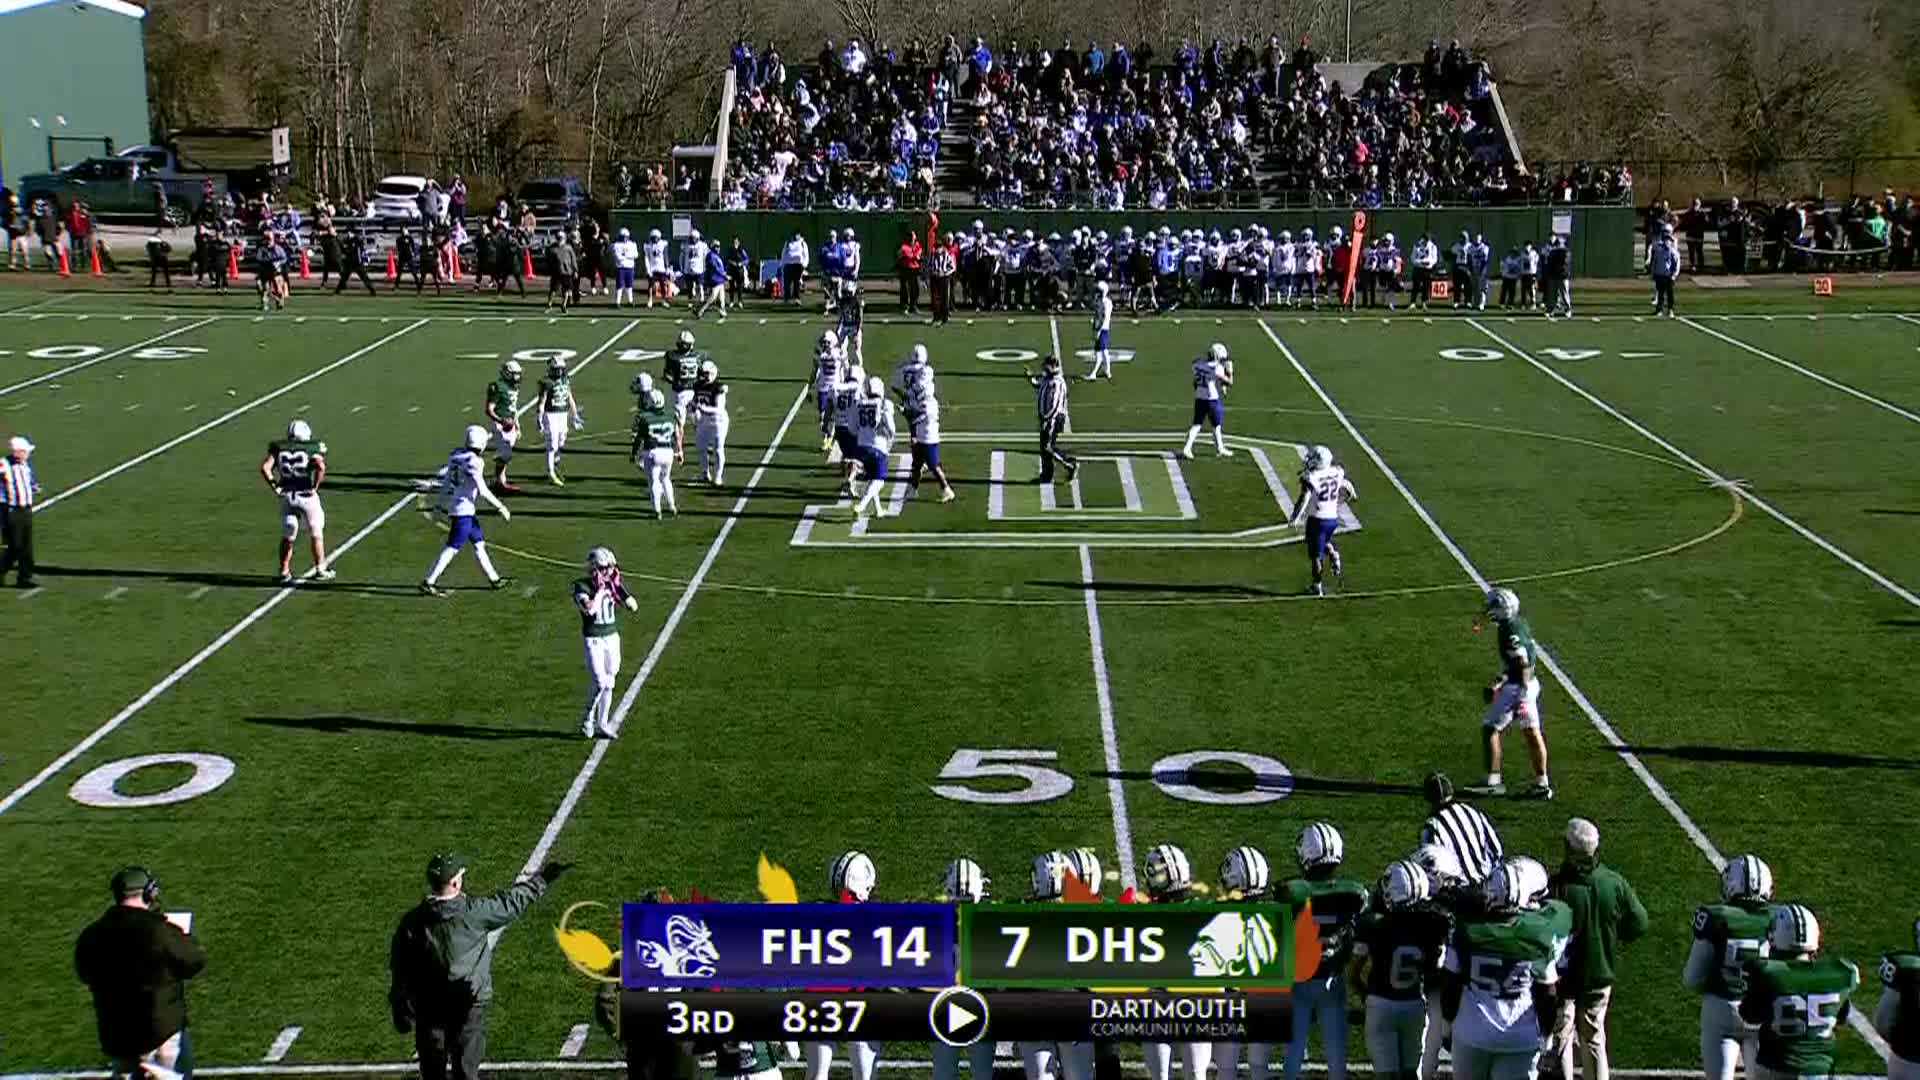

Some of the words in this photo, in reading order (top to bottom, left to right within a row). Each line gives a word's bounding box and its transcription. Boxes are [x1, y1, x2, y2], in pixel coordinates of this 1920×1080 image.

[1433, 282, 1445, 295] 40
[1318, 480, 1338, 502] 22
[933, 749, 1294, 805] 50
[1772, 993, 1840, 1039] 65
